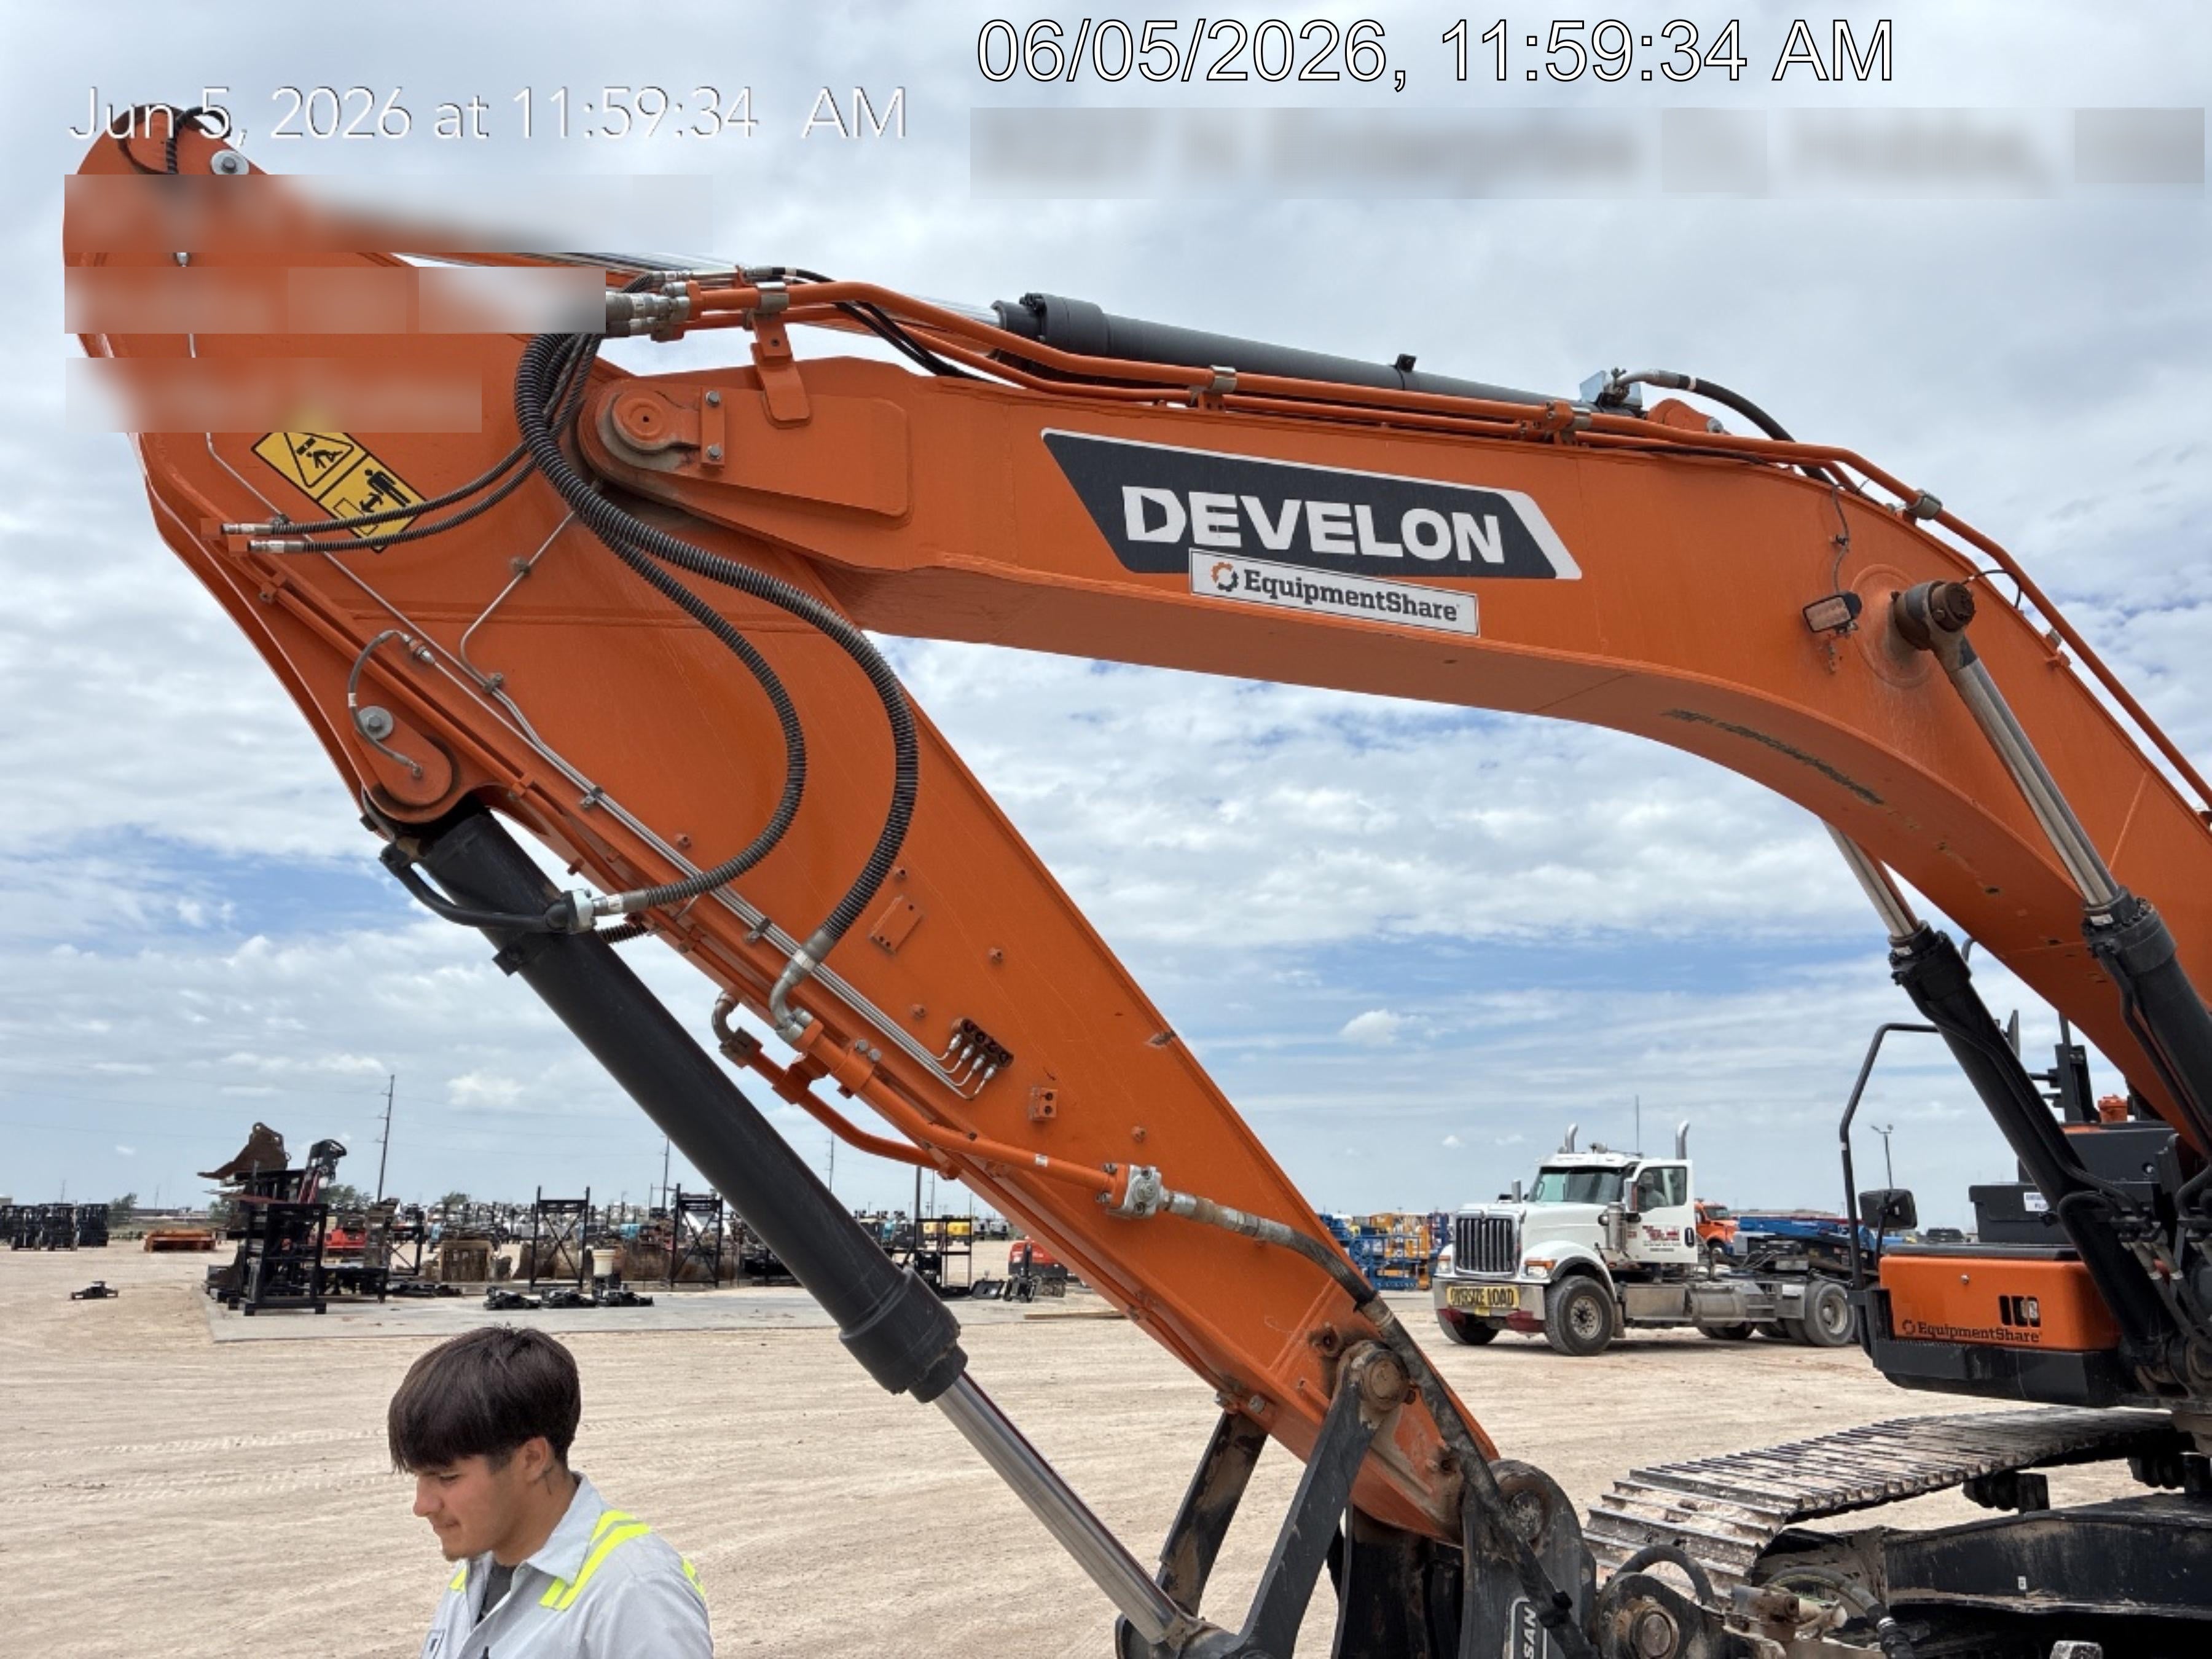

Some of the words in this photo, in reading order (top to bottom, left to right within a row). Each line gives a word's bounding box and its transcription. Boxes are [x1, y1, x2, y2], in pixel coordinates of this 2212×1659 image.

[1122, 485, 1505, 564] DEVELON
[1244, 568, 1458, 622] EquipmentShare
[1487, 1288, 1514, 1306] LOAD
[1918, 1321, 2039, 1343] EquipmentShare
